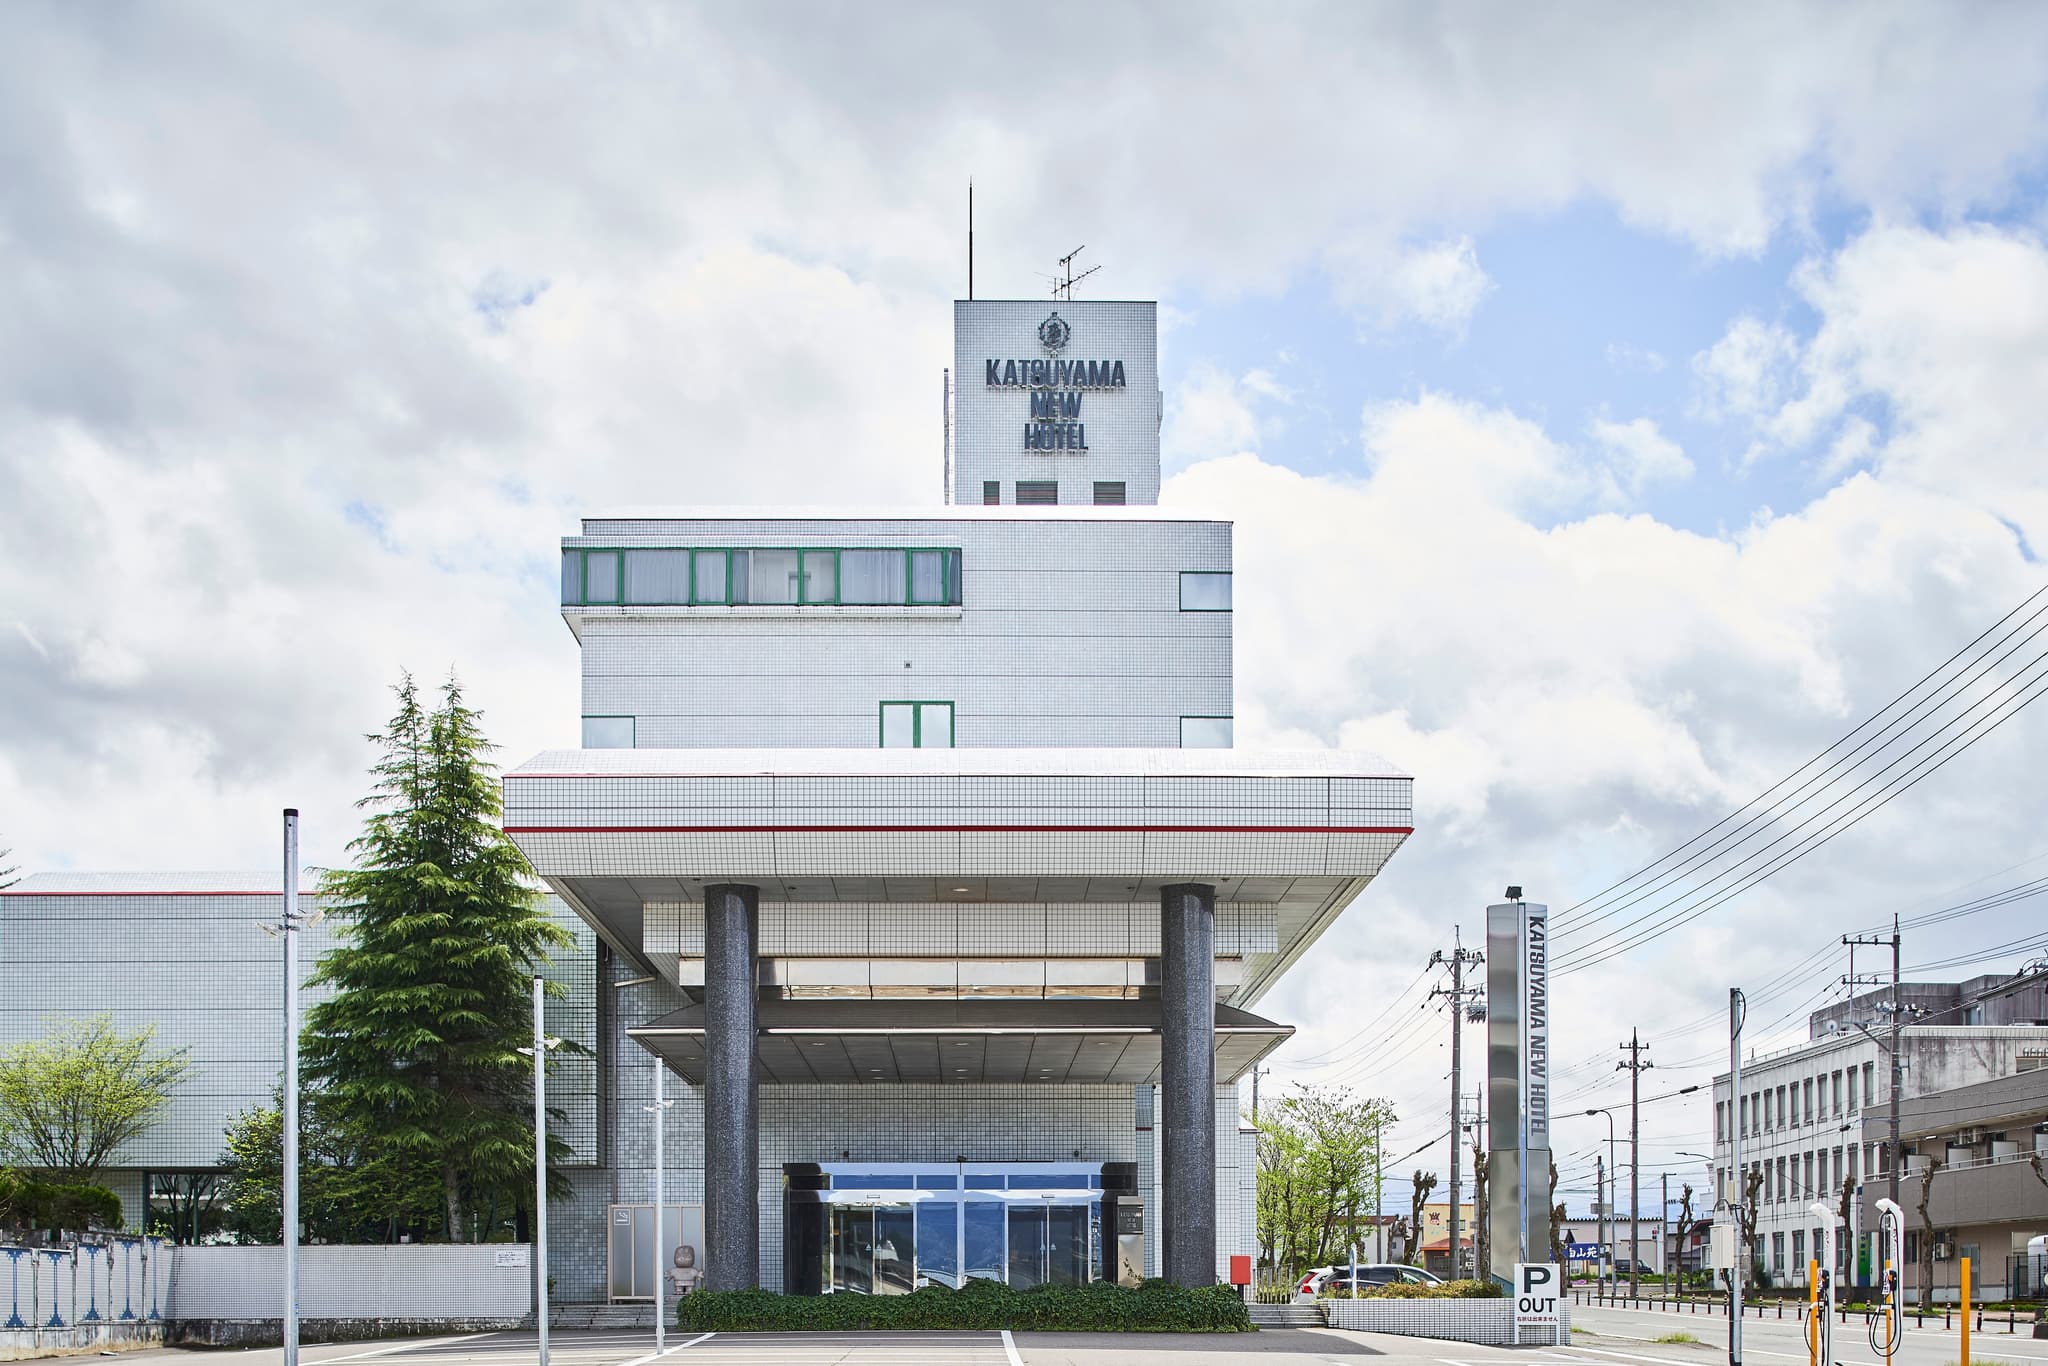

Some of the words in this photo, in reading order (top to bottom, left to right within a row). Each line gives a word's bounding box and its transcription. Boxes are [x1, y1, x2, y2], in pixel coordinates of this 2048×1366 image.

[986, 359, 1127, 388] KATSUYAMA
[1030, 391, 1083, 420] NEW
[1023, 423, 1089, 452] HOTEL
[1529, 916, 1546, 1029] KATSUYAMA
[1530, 1035, 1546, 1079] NEW
[1530, 1083, 1546, 1136] HOTEL
[1524, 1267, 1551, 1294] P
[1519, 1297, 1557, 1313] OUT
